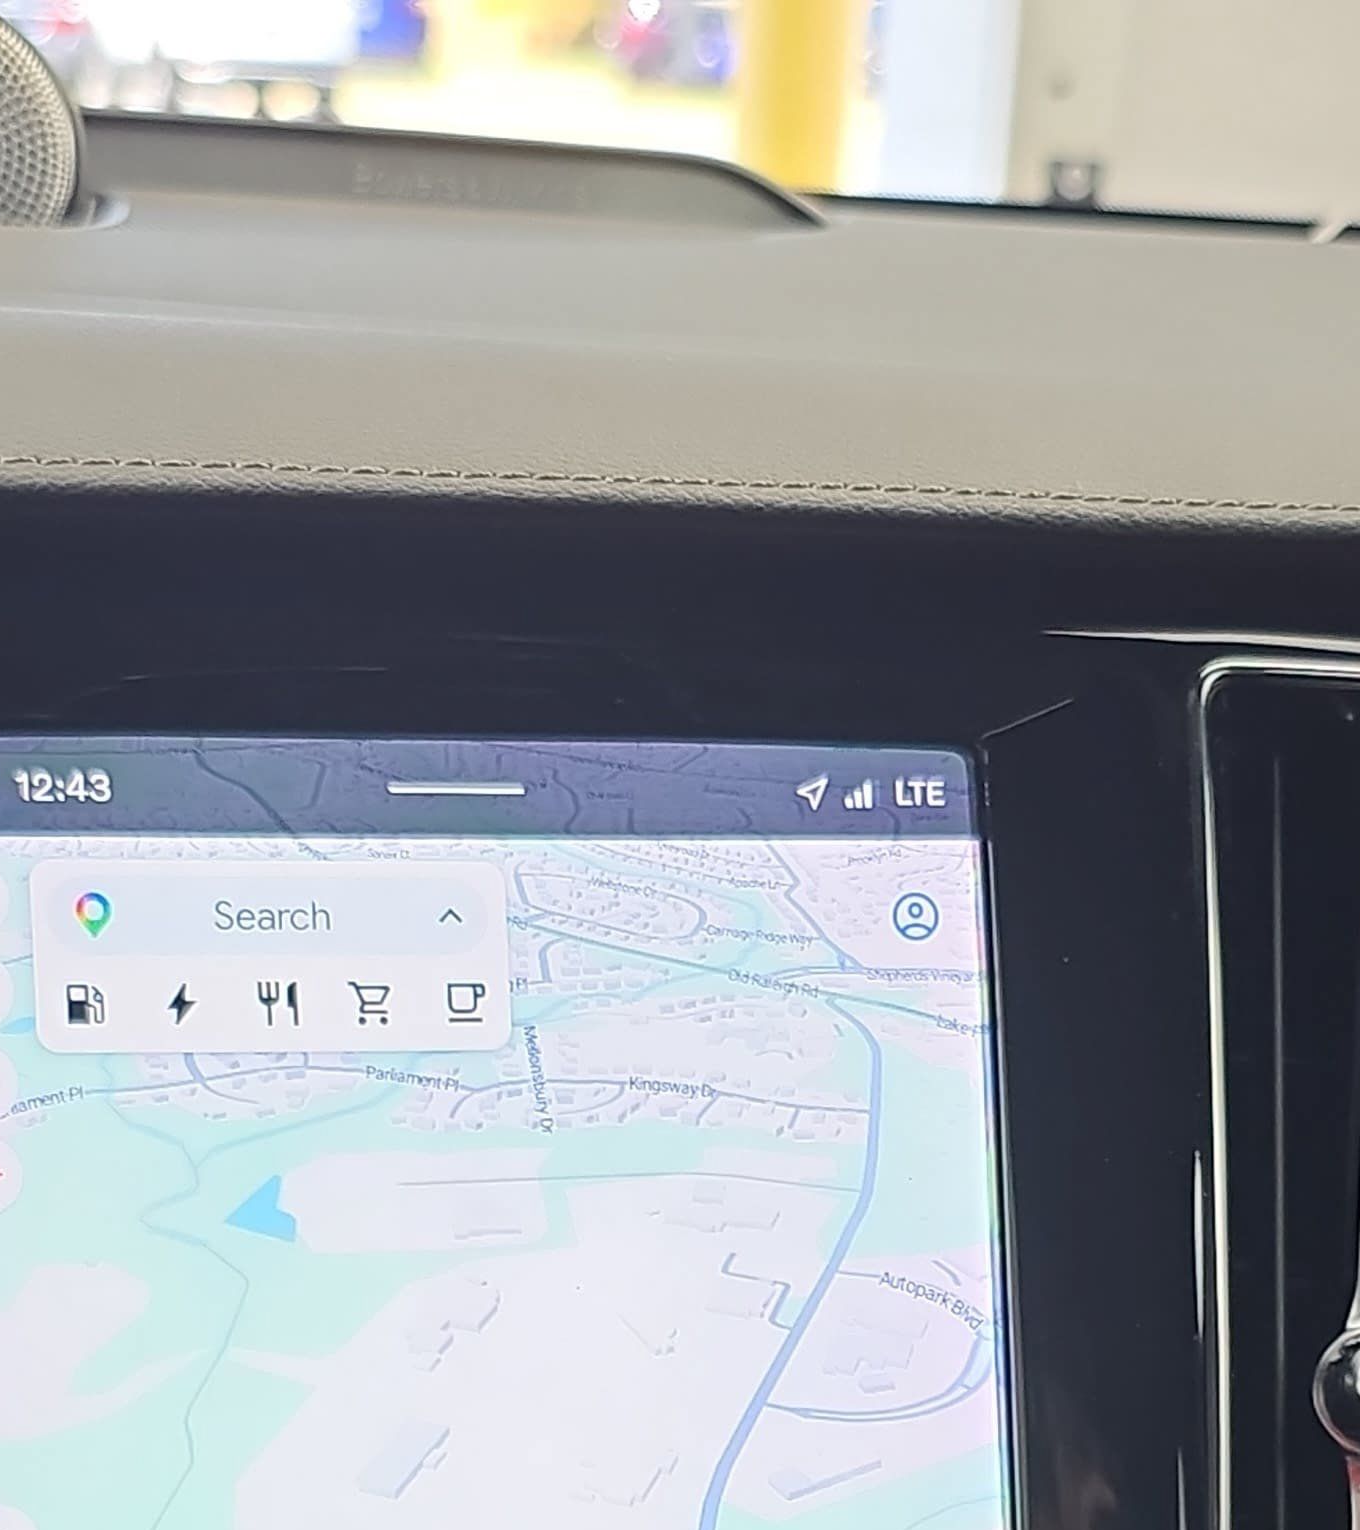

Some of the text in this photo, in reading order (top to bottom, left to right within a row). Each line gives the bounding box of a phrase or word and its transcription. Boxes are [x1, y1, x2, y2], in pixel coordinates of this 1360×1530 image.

[13, 768, 112, 803] 12:43
[895, 776, 947, 807] LTE
[214, 899, 332, 931] Search
[365, 1065, 444, 1090] Parliament
[628, 1076, 716, 1098] Kingsway Dr
[540, 1116, 554, 1134] Dr
[879, 1271, 984, 1331] Autopark Blvd
